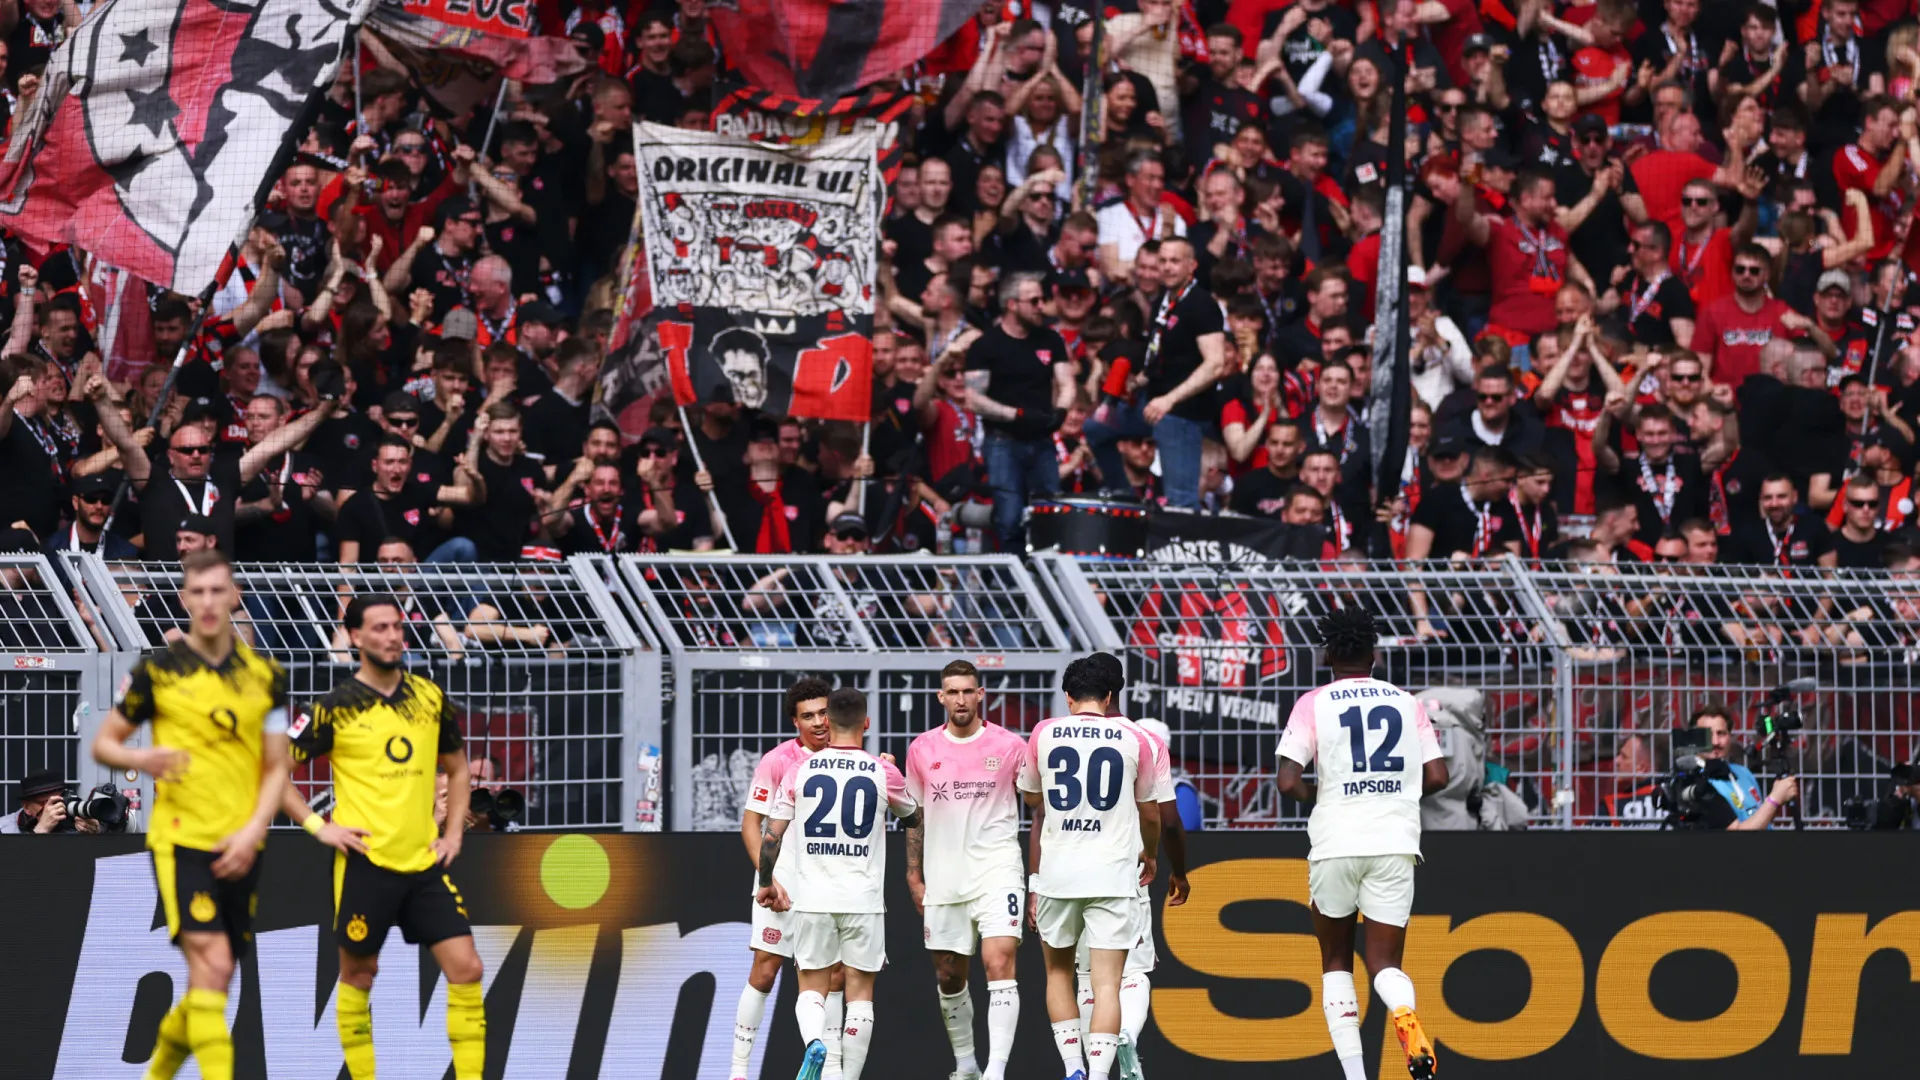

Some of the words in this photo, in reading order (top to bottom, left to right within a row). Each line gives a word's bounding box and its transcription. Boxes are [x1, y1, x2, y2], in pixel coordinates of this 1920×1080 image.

[654, 156, 808, 187] ORIGINAL
[1204, 661, 1246, 685] ROT
[1330, 688, 1379, 700] BAYER
[1383, 687, 1400, 697] 04
[1166, 687, 1214, 715] MEIN
[1219, 693, 1280, 725] VEREIN
[1052, 727, 1100, 739] BAYER
[1105, 729, 1122, 740] 04
[1338, 704, 1405, 773] 12
[809, 759, 855, 770] BAYER
[859, 760, 877, 773] 04
[953, 780, 996, 790] Barmenia
[1047, 745, 1124, 812] 30
[1343, 780, 1402, 796] TAPSOBA
[954, 790, 990, 800] Gothaer
[803, 774, 878, 839] 20
[1061, 819, 1101, 832] MAZA
[806, 843, 869, 858] GRIMALDO
[1007, 893, 1019, 917] 8
[50, 834, 785, 1080] bwin
